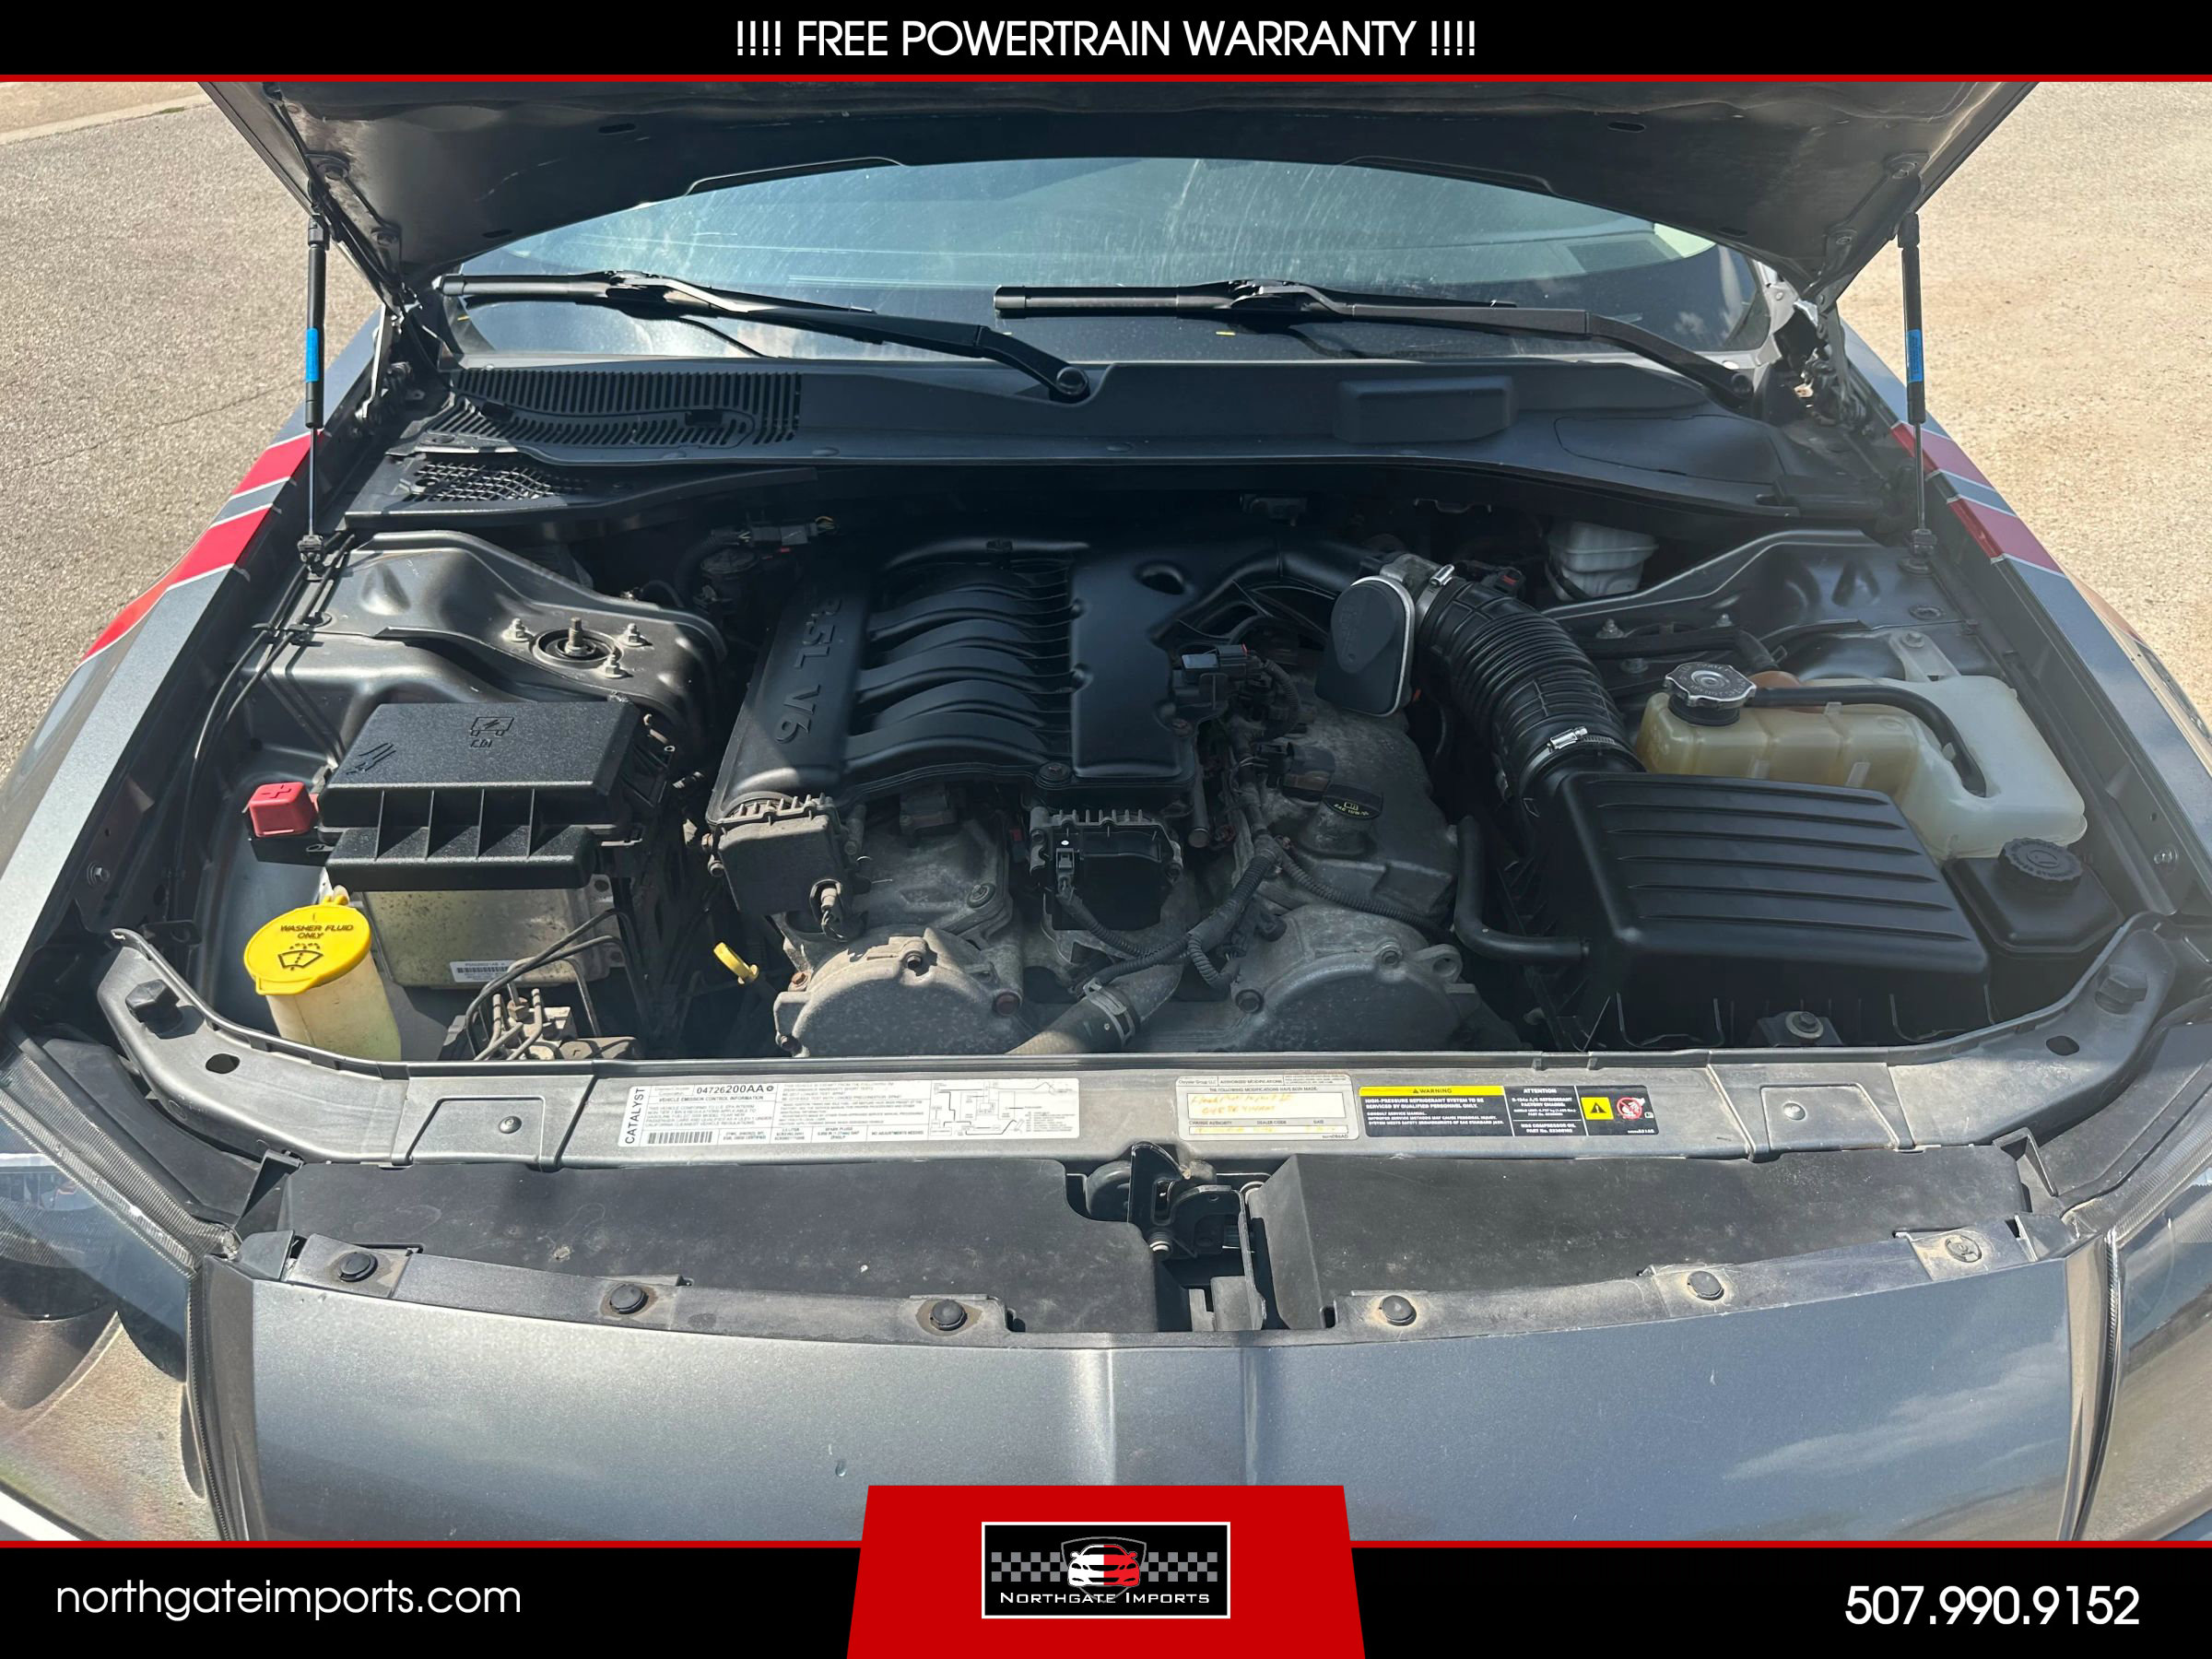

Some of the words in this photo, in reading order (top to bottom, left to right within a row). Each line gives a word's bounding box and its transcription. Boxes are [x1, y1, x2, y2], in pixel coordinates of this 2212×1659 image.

[775, 684, 821, 744] V6
[625, 1087, 645, 1145] CATALYST
[697, 1085, 764, 1094] 04726200AA
